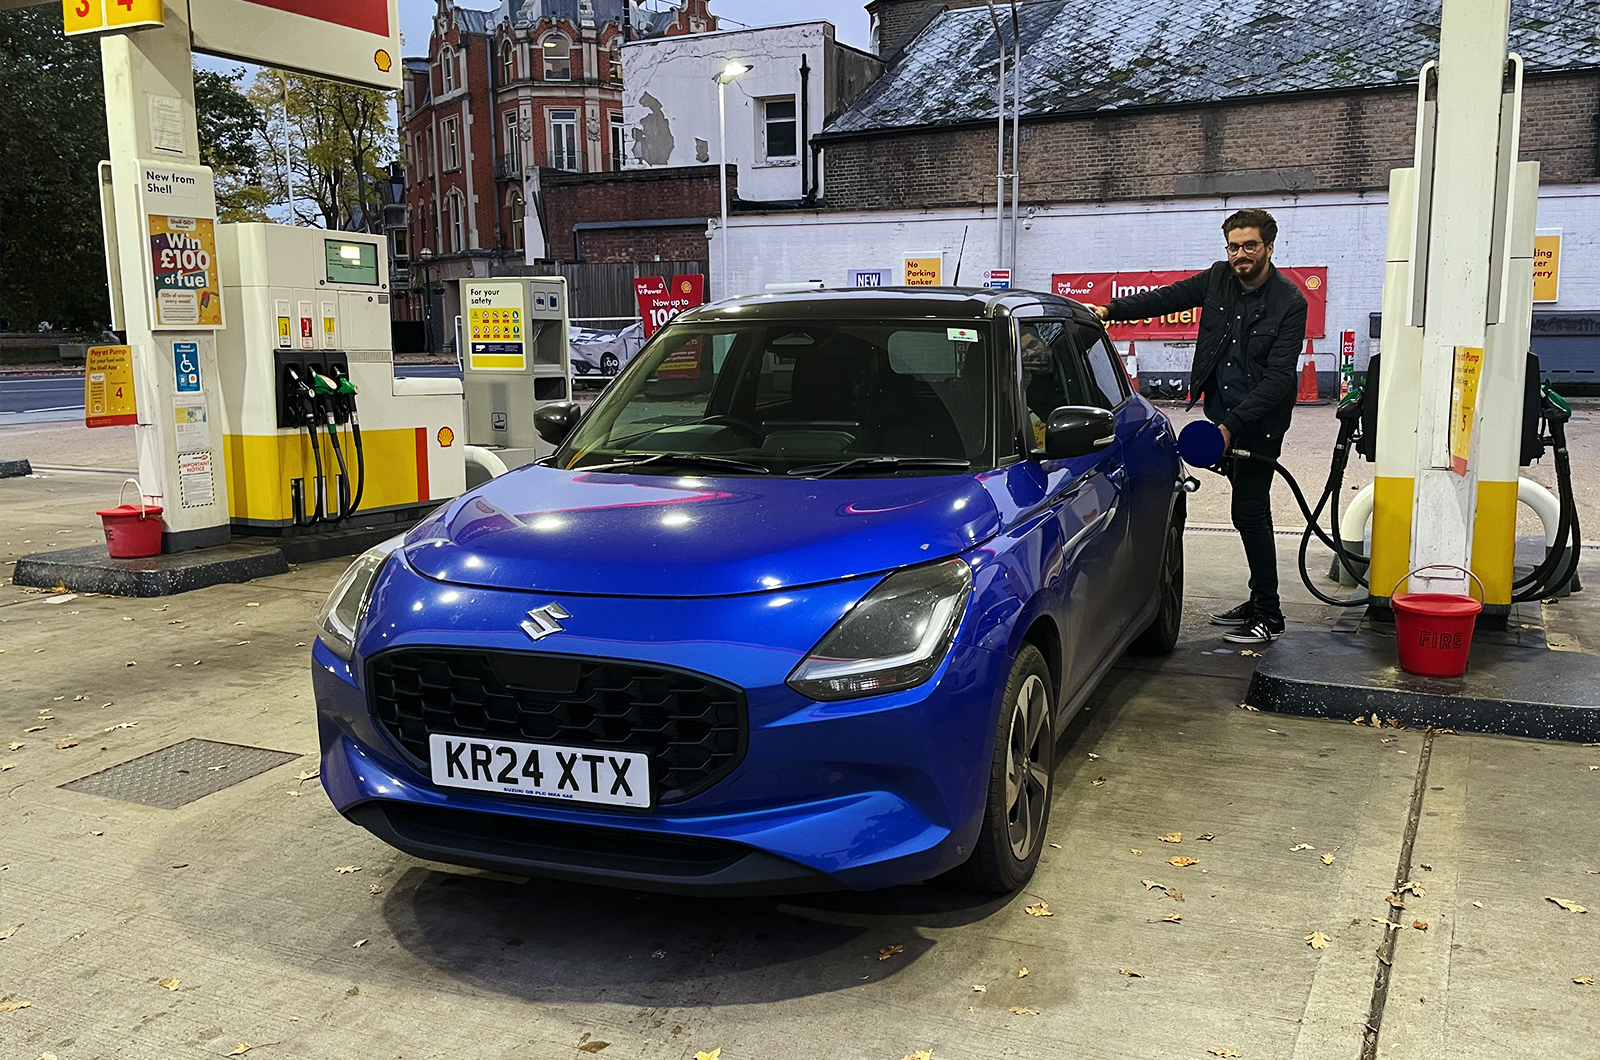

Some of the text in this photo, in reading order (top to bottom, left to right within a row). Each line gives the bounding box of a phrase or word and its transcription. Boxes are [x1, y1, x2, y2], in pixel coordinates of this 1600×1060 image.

[146, 171, 195, 184] New from
[147, 183, 172, 194] Shell
[166, 232, 201, 249] Win
[161, 248, 210, 270] £100
[165, 269, 209, 287] of fuel
[857, 273, 879, 287] NEW
[907, 270, 936, 278] Parking
[1058, 287, 1091, 295] V-Power
[652, 299, 669, 307] Now
[109, 348, 126, 356] Pump
[115, 386, 123, 398] 4
[1462, 415, 1467, 431] 5
[181, 460, 210, 468] IMPORTANT
[1419, 630, 1463, 649] FIRE
[446, 741, 633, 797] KR24 XTX
